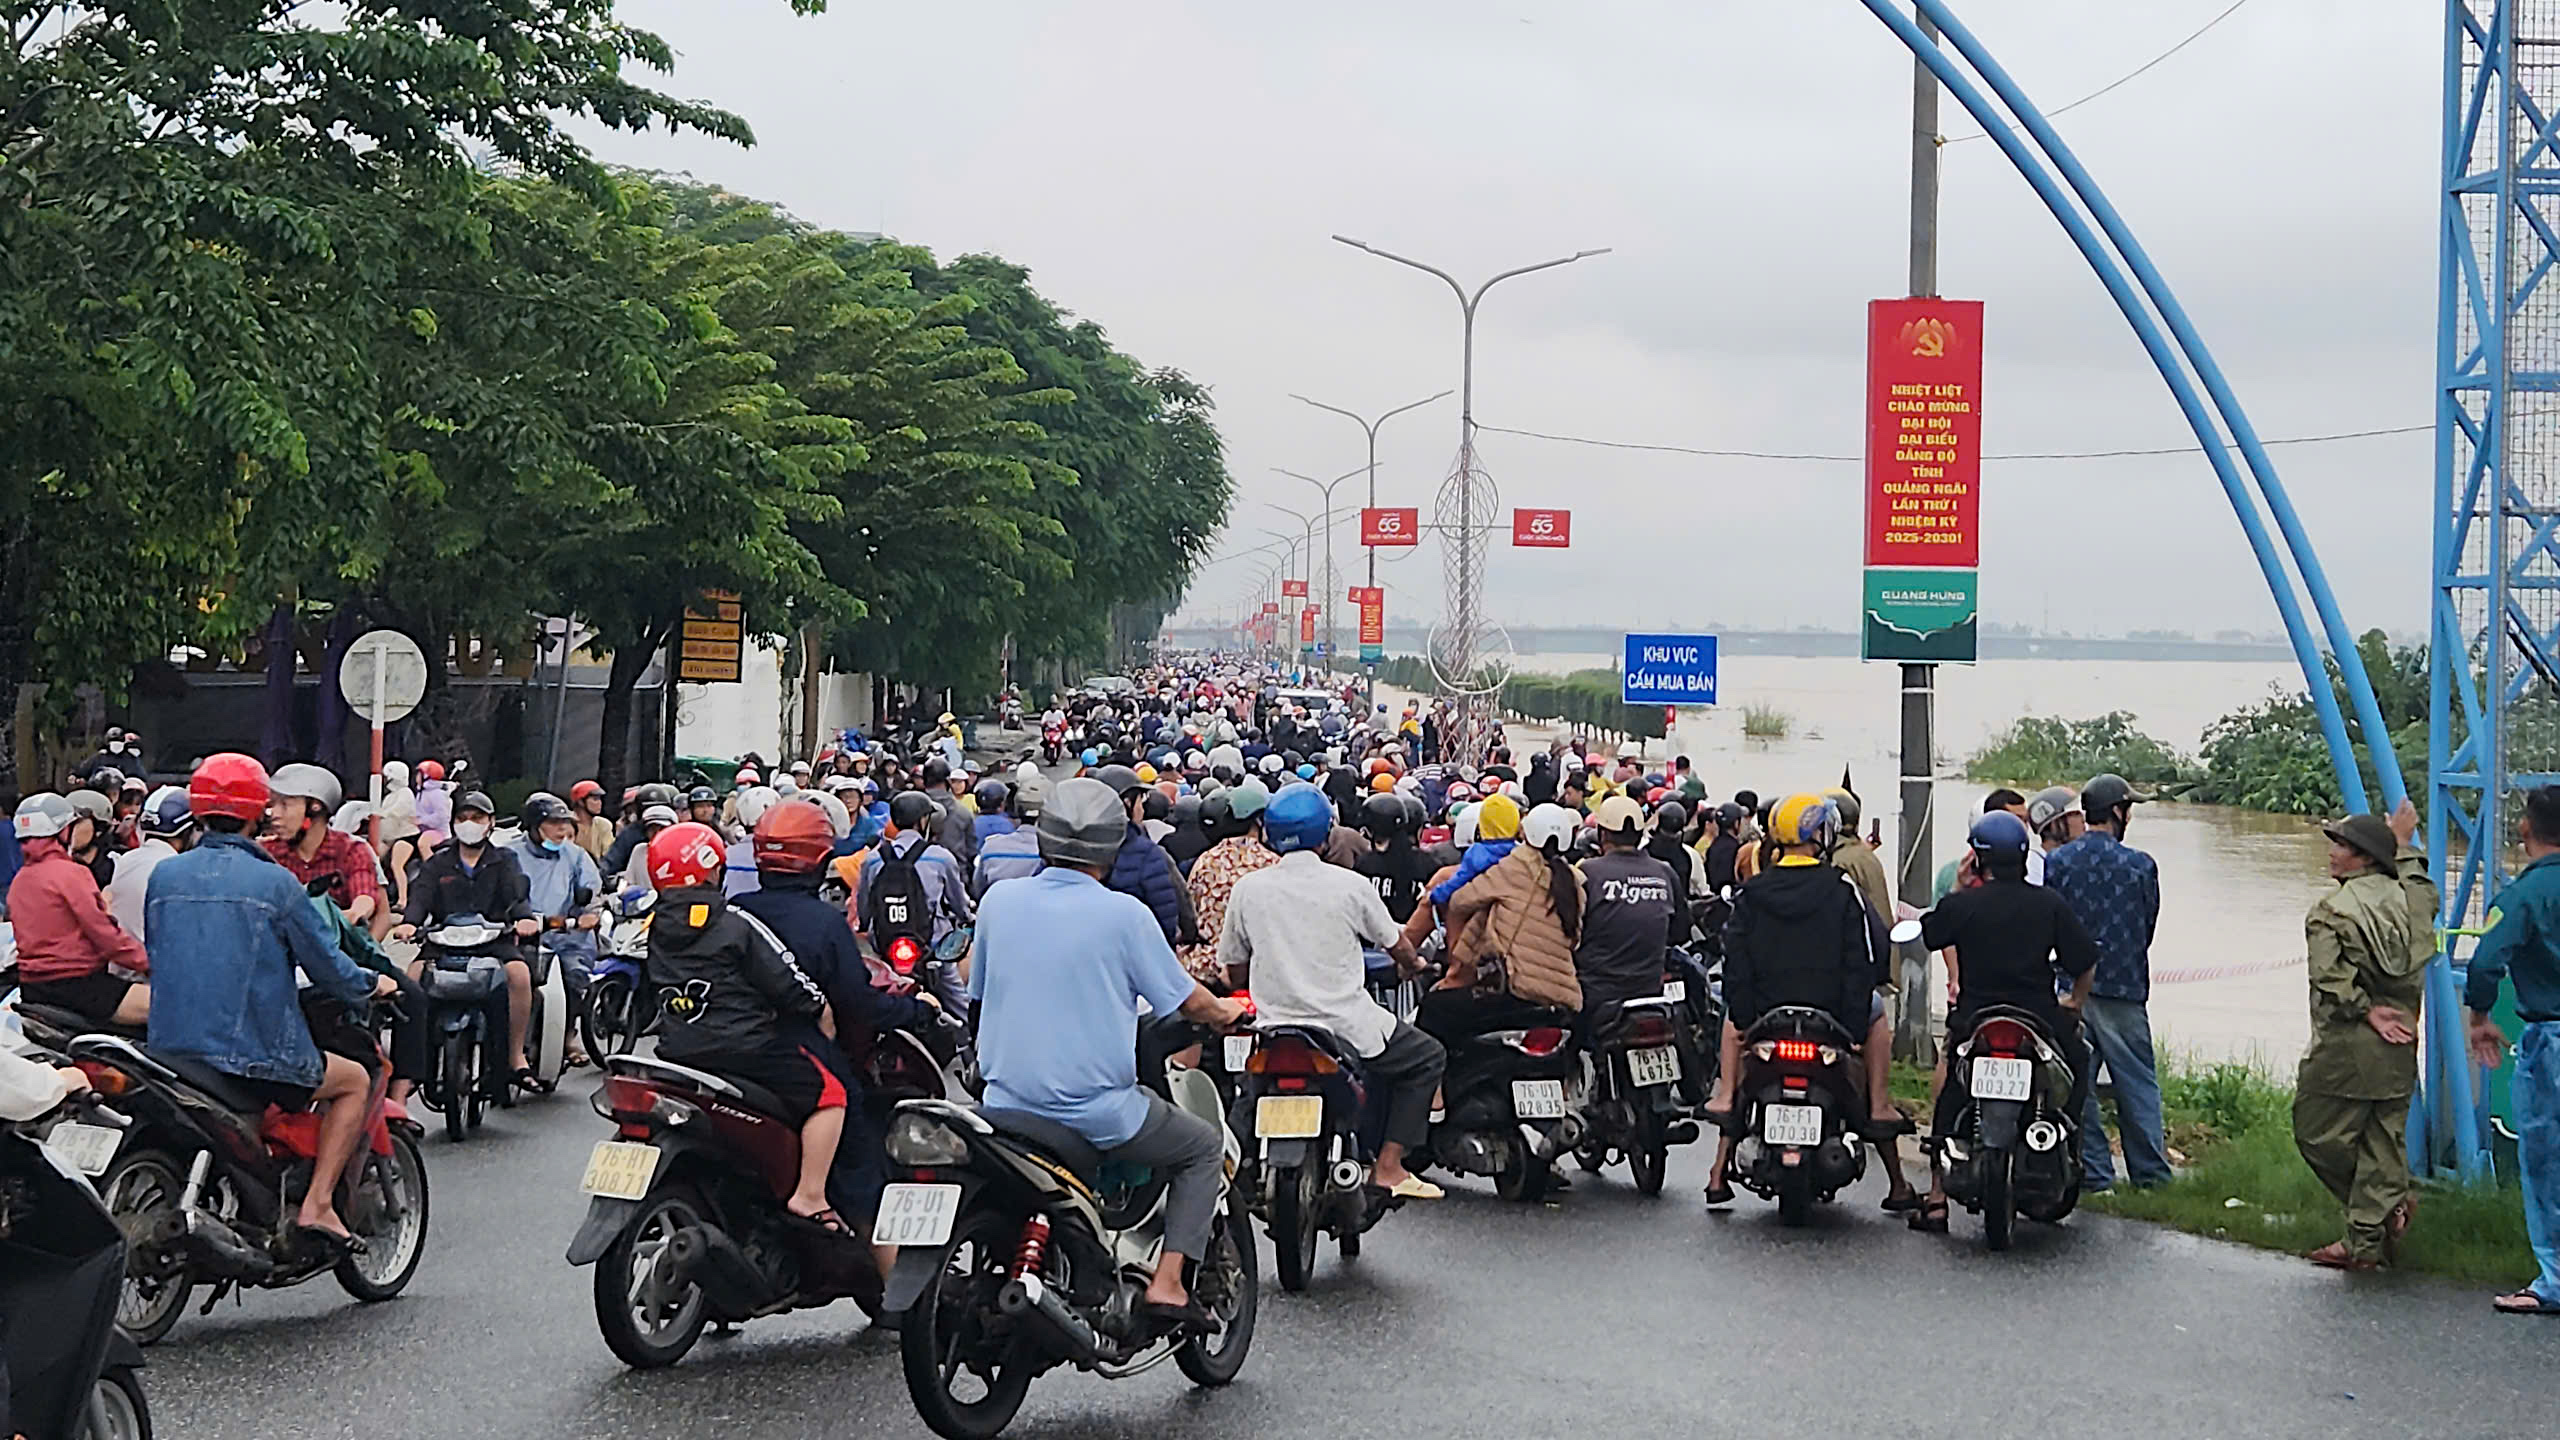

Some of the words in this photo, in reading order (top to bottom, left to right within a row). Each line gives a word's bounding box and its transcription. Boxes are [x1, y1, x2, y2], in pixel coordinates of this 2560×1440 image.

[1531, 518, 1553, 535] 5G
[1885, 532, 1962, 544] 2025-2030!
[1643, 646, 1670, 663] KHU
[1672, 646, 1698, 667] VỰC
[1657, 673, 1685, 691] MUA
[1687, 671, 1714, 692] BÁN
[1602, 879, 1667, 904] Tigers
[889, 905, 908, 923] 09
[600, 1145, 649, 1169] 76-H1
[892, 1189, 945, 1214] 76-U1
[887, 1216, 939, 1240] 1071
